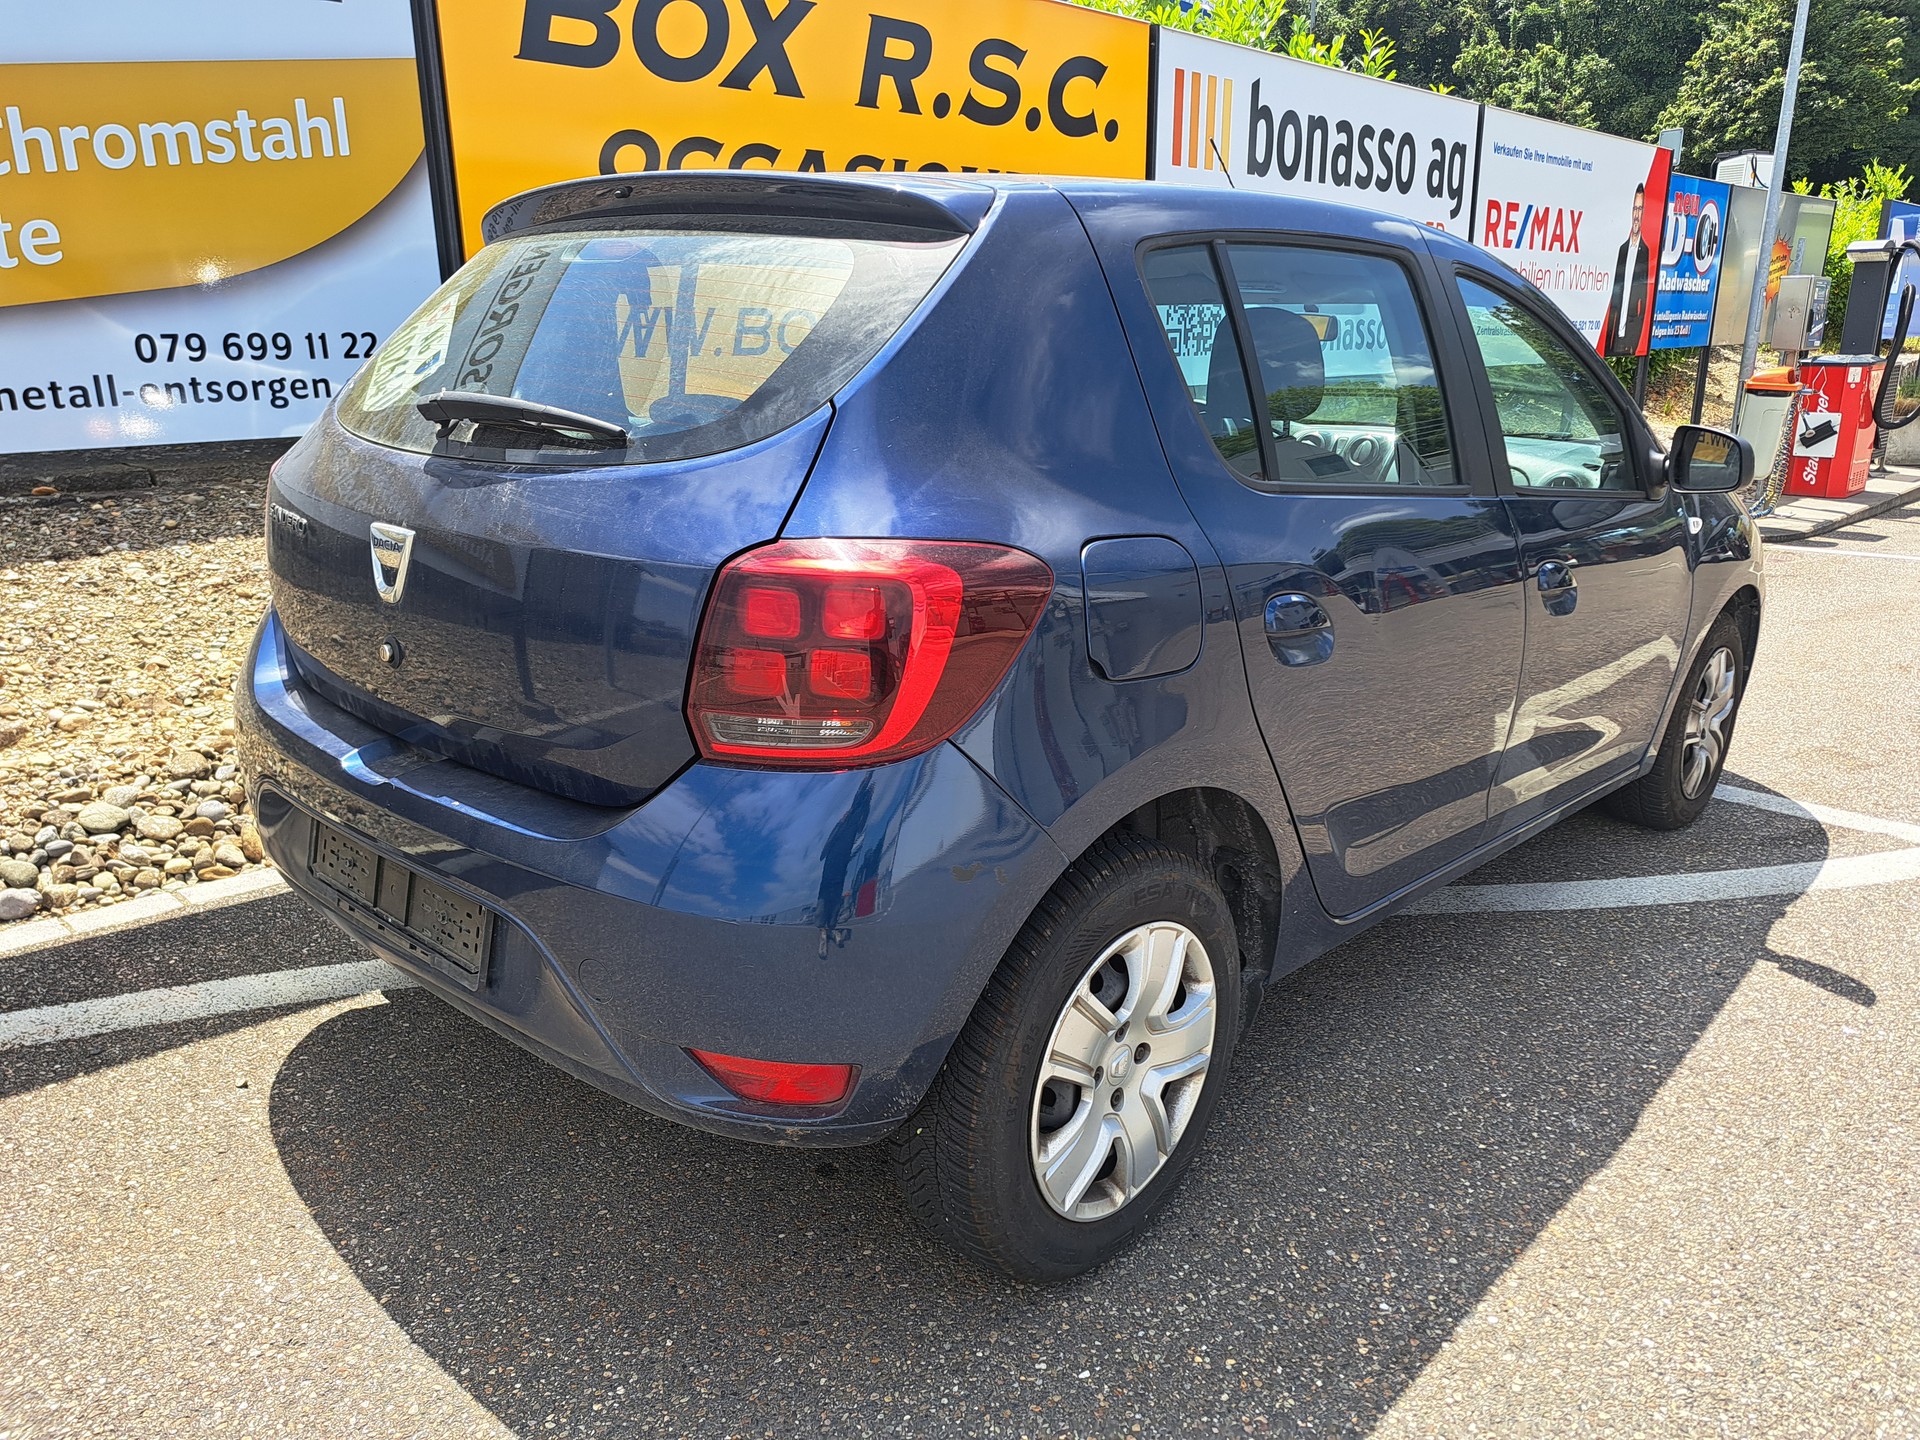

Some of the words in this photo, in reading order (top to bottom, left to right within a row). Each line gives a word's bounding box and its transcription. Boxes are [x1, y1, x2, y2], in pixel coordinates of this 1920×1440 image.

[854, 13, 1119, 143] R.S.C.
[0, 97, 351, 176] hromstahl
[1247, 77, 1416, 195] bonasso
[1426, 137, 1467, 220] ag
[1493, 141, 1523, 159] Verkaufen
[1523, 147, 1533, 161] Sie
[1534, 149, 1545, 163] Ihre
[1546, 152, 1572, 168] Immobilie
[1572, 158, 1581, 170] mit
[1673, 190, 1701, 217] neu
[1483, 198, 1584, 254] RE/MAX
[1554, 263, 1566, 290] in
[1569, 263, 1610, 292] Wohlen
[1658, 270, 1711, 292] Radwäscher
[134, 333, 208, 365] 079
[222, 331, 293, 362] 699
[304, 332, 330, 361] 11
[343, 331, 378, 360] 22
[372, 536, 401, 553] DACIA
